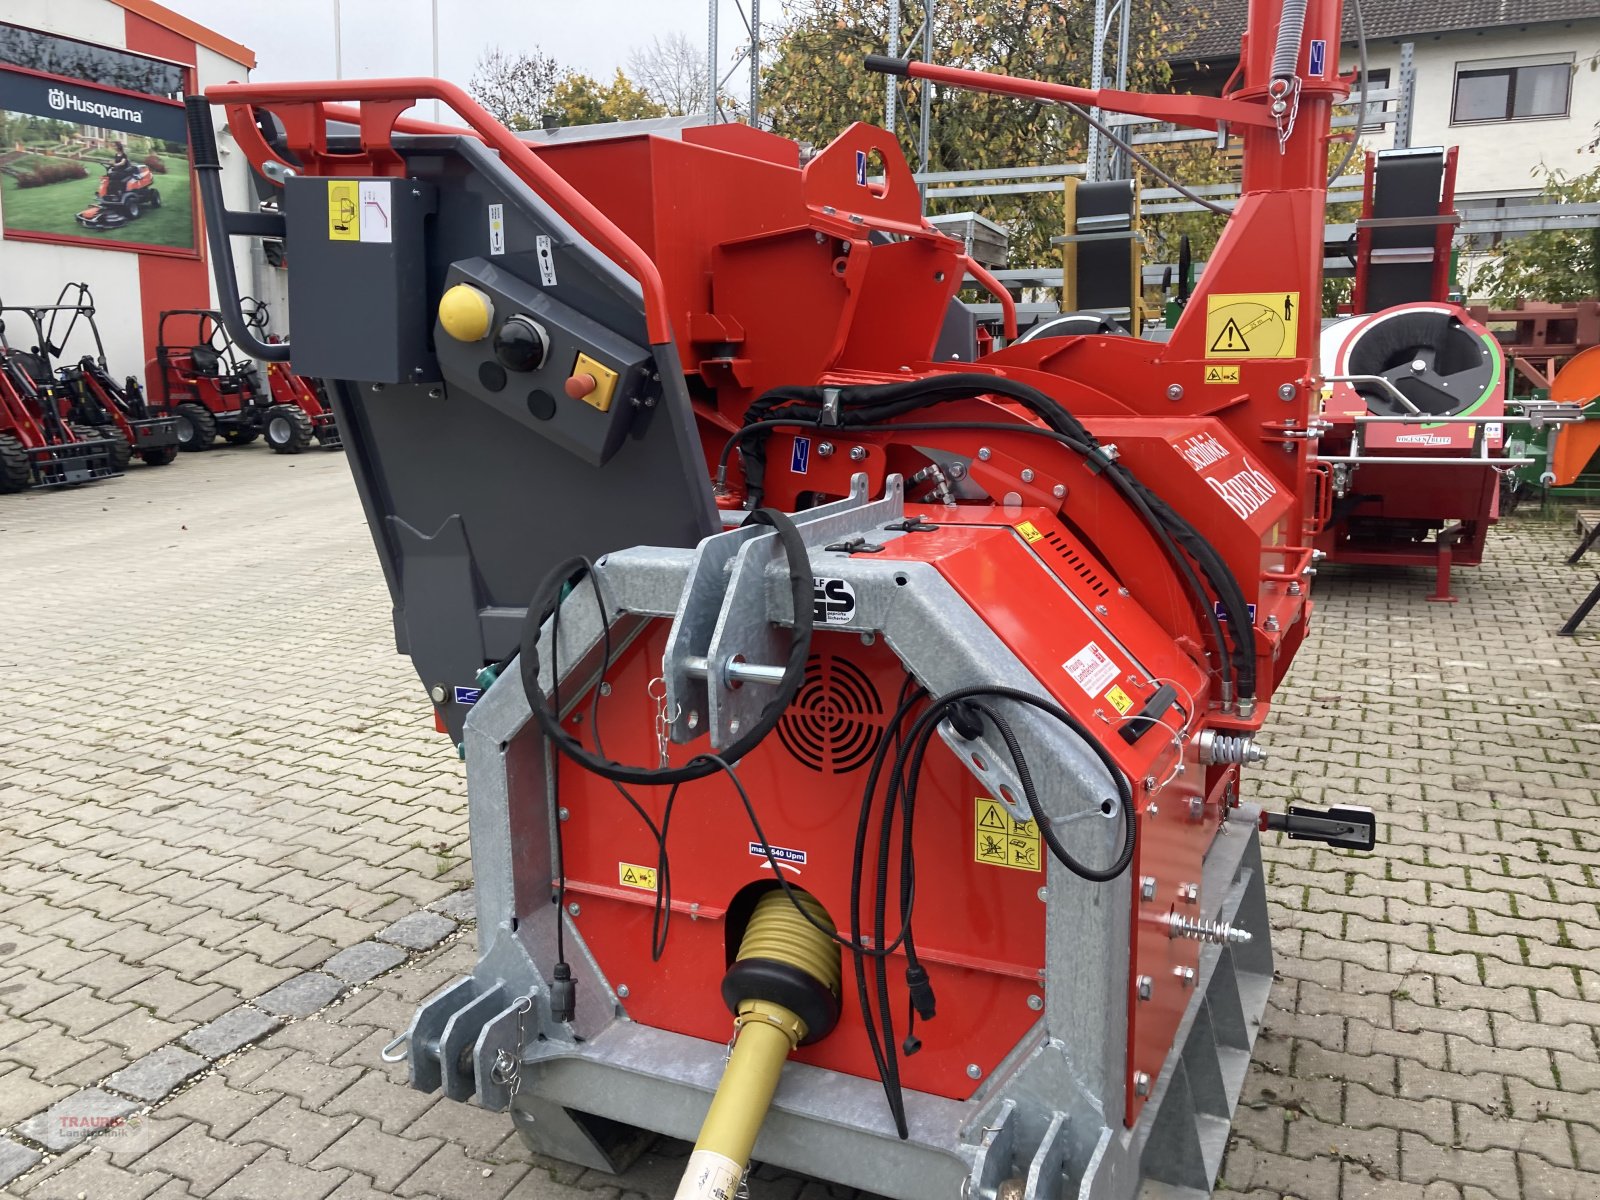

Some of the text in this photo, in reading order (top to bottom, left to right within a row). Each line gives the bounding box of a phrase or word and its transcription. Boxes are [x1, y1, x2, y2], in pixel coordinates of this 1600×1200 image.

[65, 94, 142, 123] Husqvarna
[1172, 431, 1230, 472] Eschlböck
[813, 579, 825, 588] LF
[771, 849, 785, 857] 540
[786, 851, 804, 861] Upm
